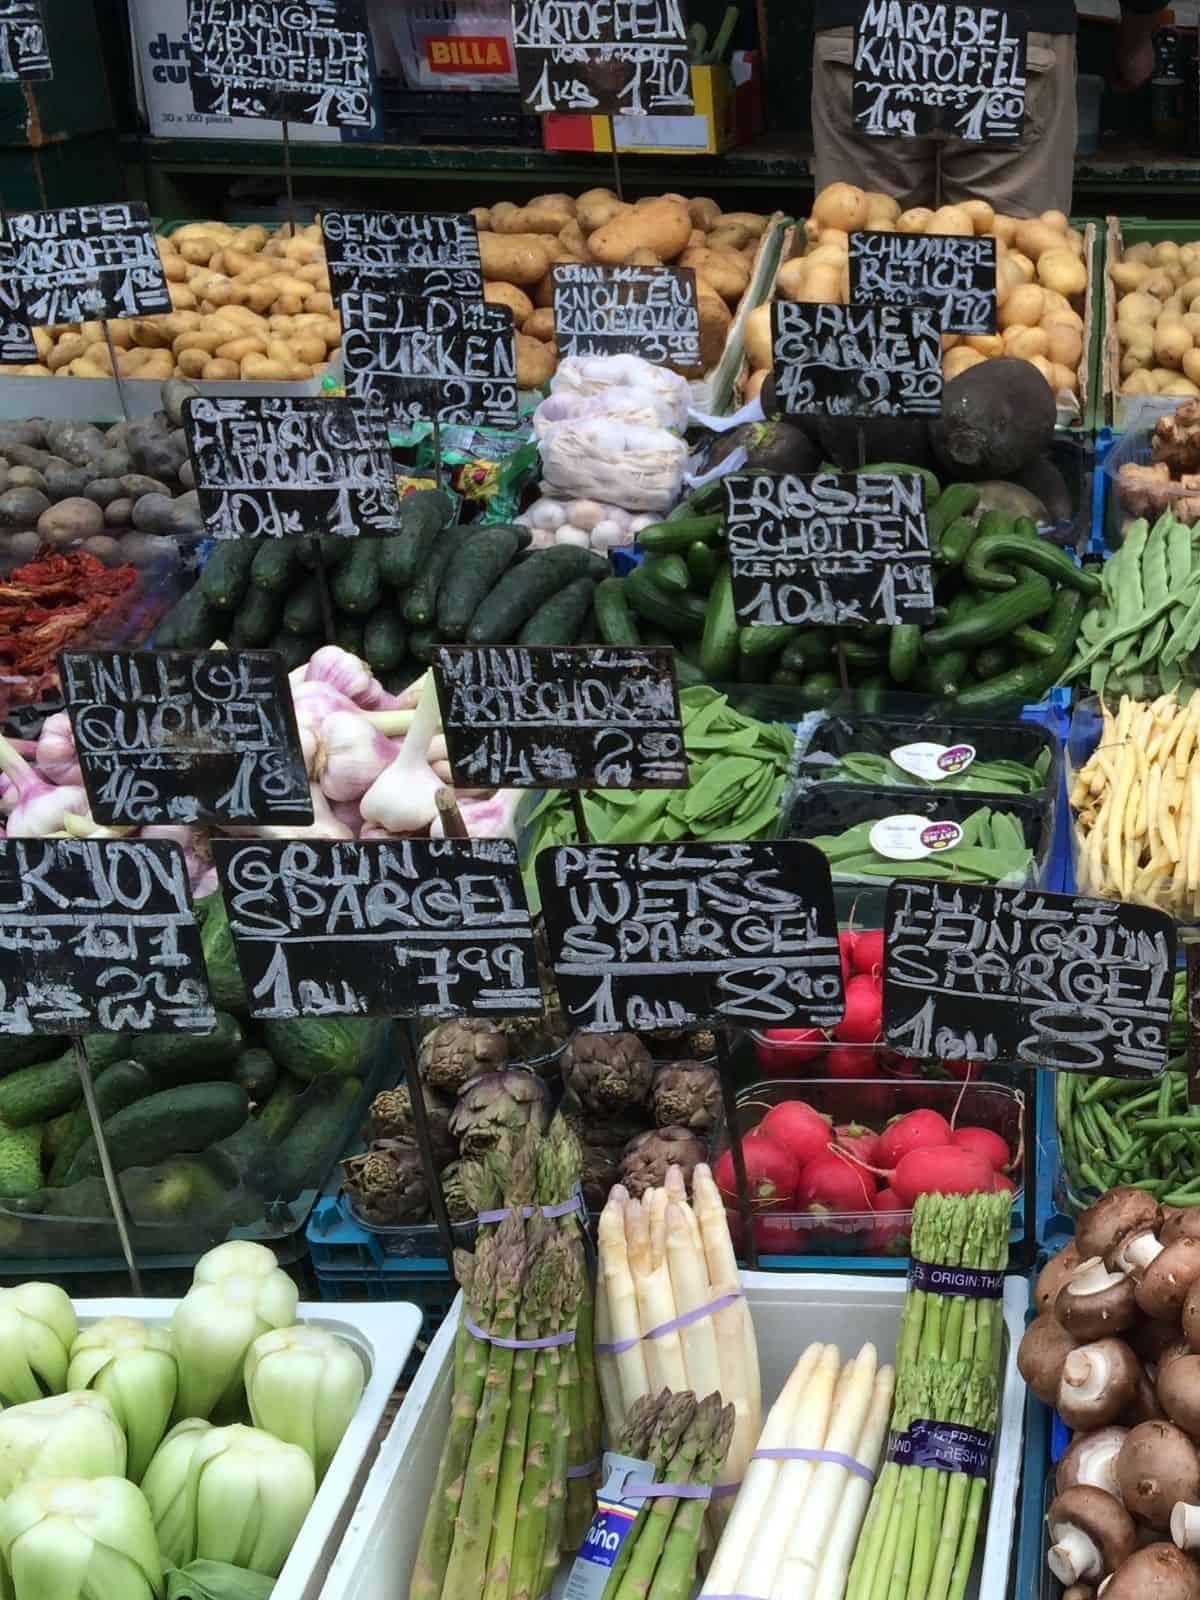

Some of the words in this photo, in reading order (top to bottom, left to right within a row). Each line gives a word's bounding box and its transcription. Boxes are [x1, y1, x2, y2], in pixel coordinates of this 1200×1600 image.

[860, 0, 1020, 47] MARABEL
[431, 41, 503, 66] BILLA
[854, 35, 1027, 87] KARTOFFEL
[322, 214, 480, 243] GEKOCHTE
[340, 293, 457, 334] FELD
[779, 303, 941, 340] BAUER
[342, 330, 518, 378] GURKEN
[775, 334, 942, 369] GURKEN
[723, 474, 924, 522] ERBSEN
[729, 514, 928, 556] SCHOTTEN
[226, 838, 419, 892] GRÜN
[229, 872, 530, 937] SPARGEL
[569, 868, 803, 925] WEISS
[560, 905, 840, 963] SPARGEL
[886, 944, 1171, 1010] SPARGEL
